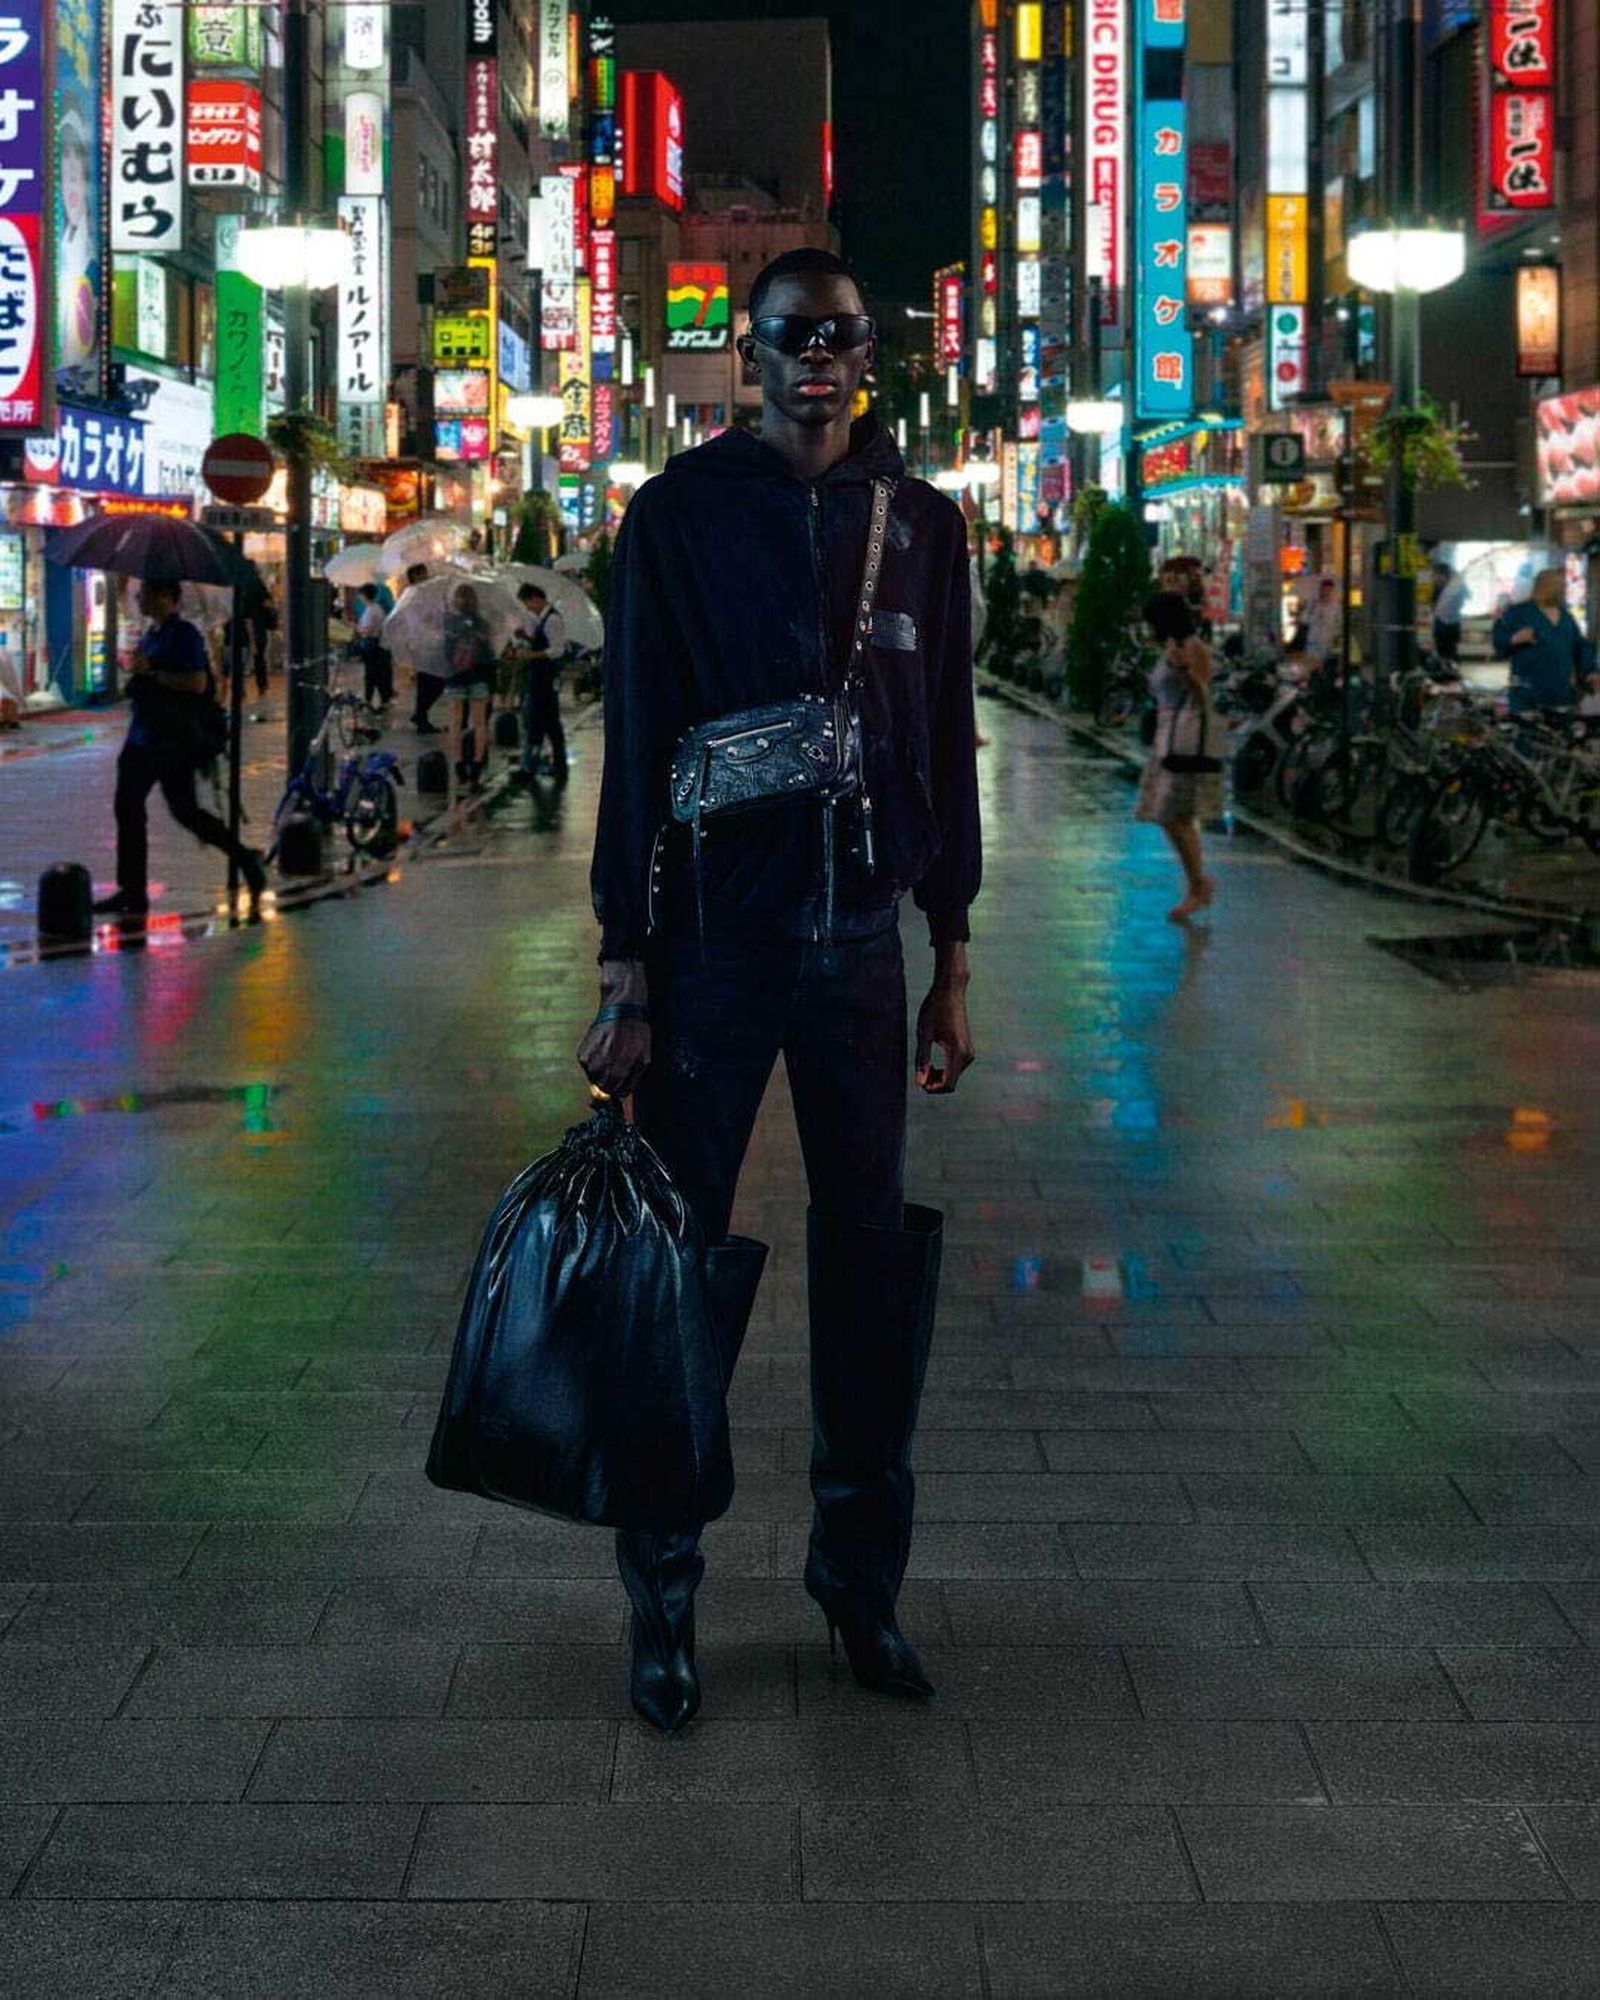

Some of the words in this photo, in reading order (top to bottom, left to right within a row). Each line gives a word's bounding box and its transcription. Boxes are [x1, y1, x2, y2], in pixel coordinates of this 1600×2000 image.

[121, 34, 175, 239] にいむら
[1093, 54, 1118, 146] DRUG
[1508, 142, 1542, 193] 一休
[1153, 127, 1183, 389] カラオケ館
[0, 245, 26, 376] たばこ
[346, 285, 374, 392] ルノアール
[61, 414, 145, 488] カラオケ
[594, 385, 612, 454] カラオケ
